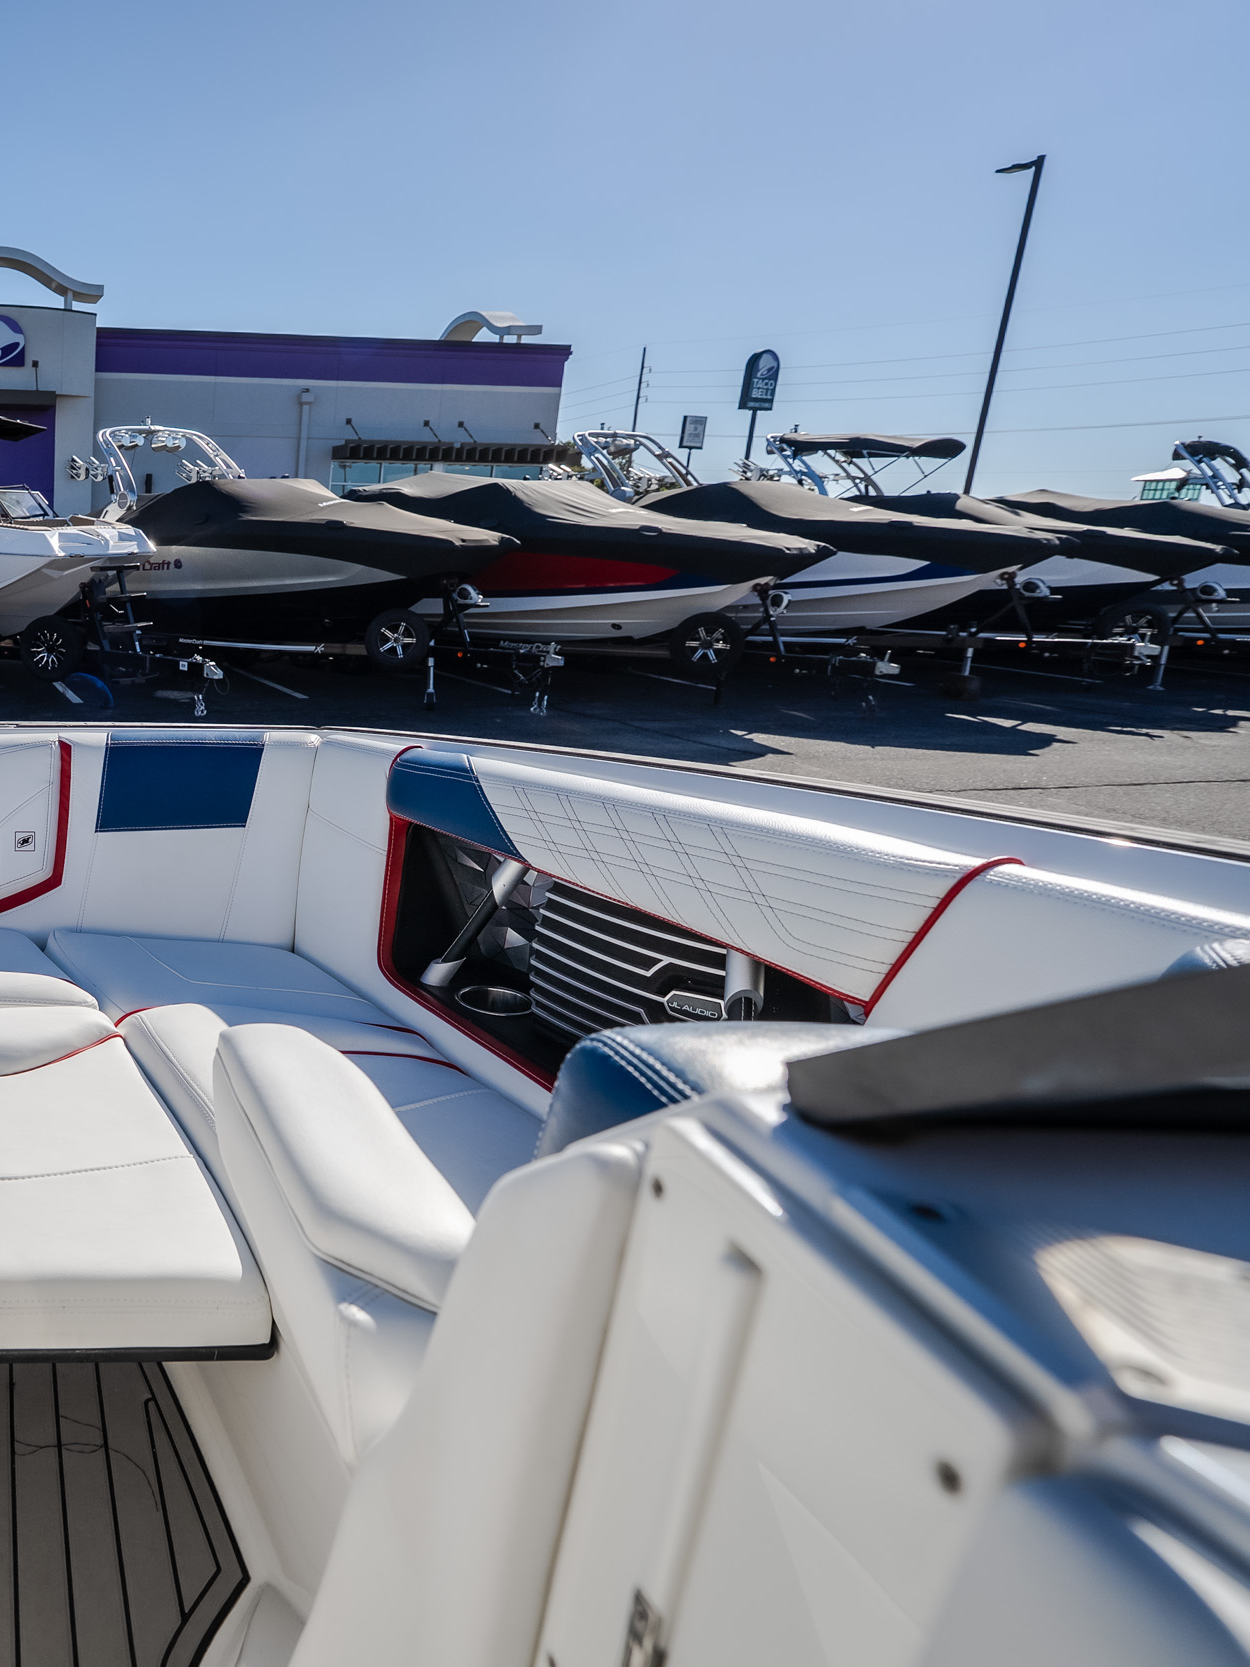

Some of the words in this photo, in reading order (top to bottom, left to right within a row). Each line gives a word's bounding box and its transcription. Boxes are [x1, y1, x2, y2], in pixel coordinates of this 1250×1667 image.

[753, 378, 775, 389] TACO
[751, 388, 773, 398] BELL
[668, 1001, 681, 1009] JL
[681, 1004, 718, 1018] AUDIO
